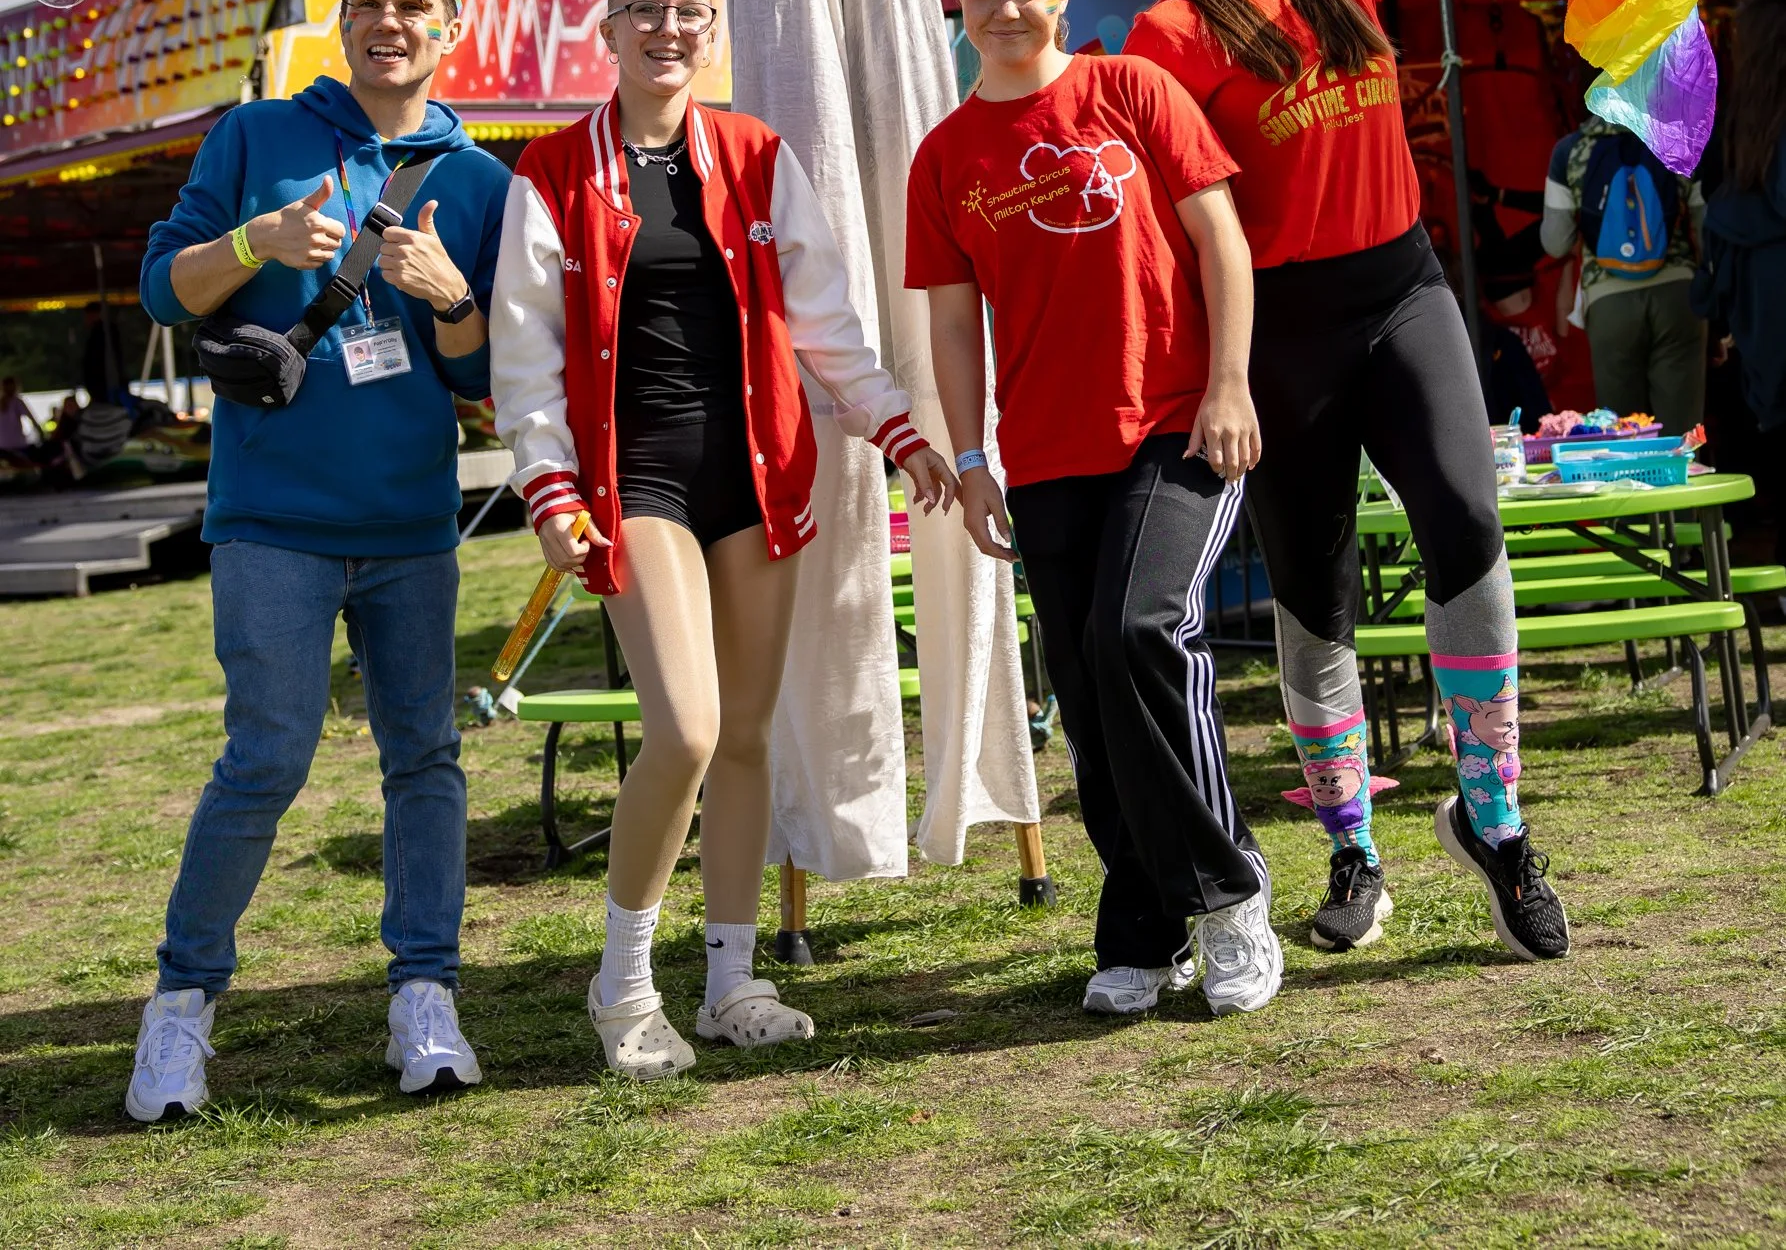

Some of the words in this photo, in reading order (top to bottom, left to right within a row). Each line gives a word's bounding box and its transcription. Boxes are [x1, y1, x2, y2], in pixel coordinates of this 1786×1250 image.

[1260, 85, 1350, 146] SHOWTIME
[1344, 112, 1364, 127] Jess
[987, 180, 1037, 207] Showtime
[1039, 166, 1071, 184] Circus
[994, 202, 1029, 222] Milton
[1030, 185, 1070, 206] Keynes
